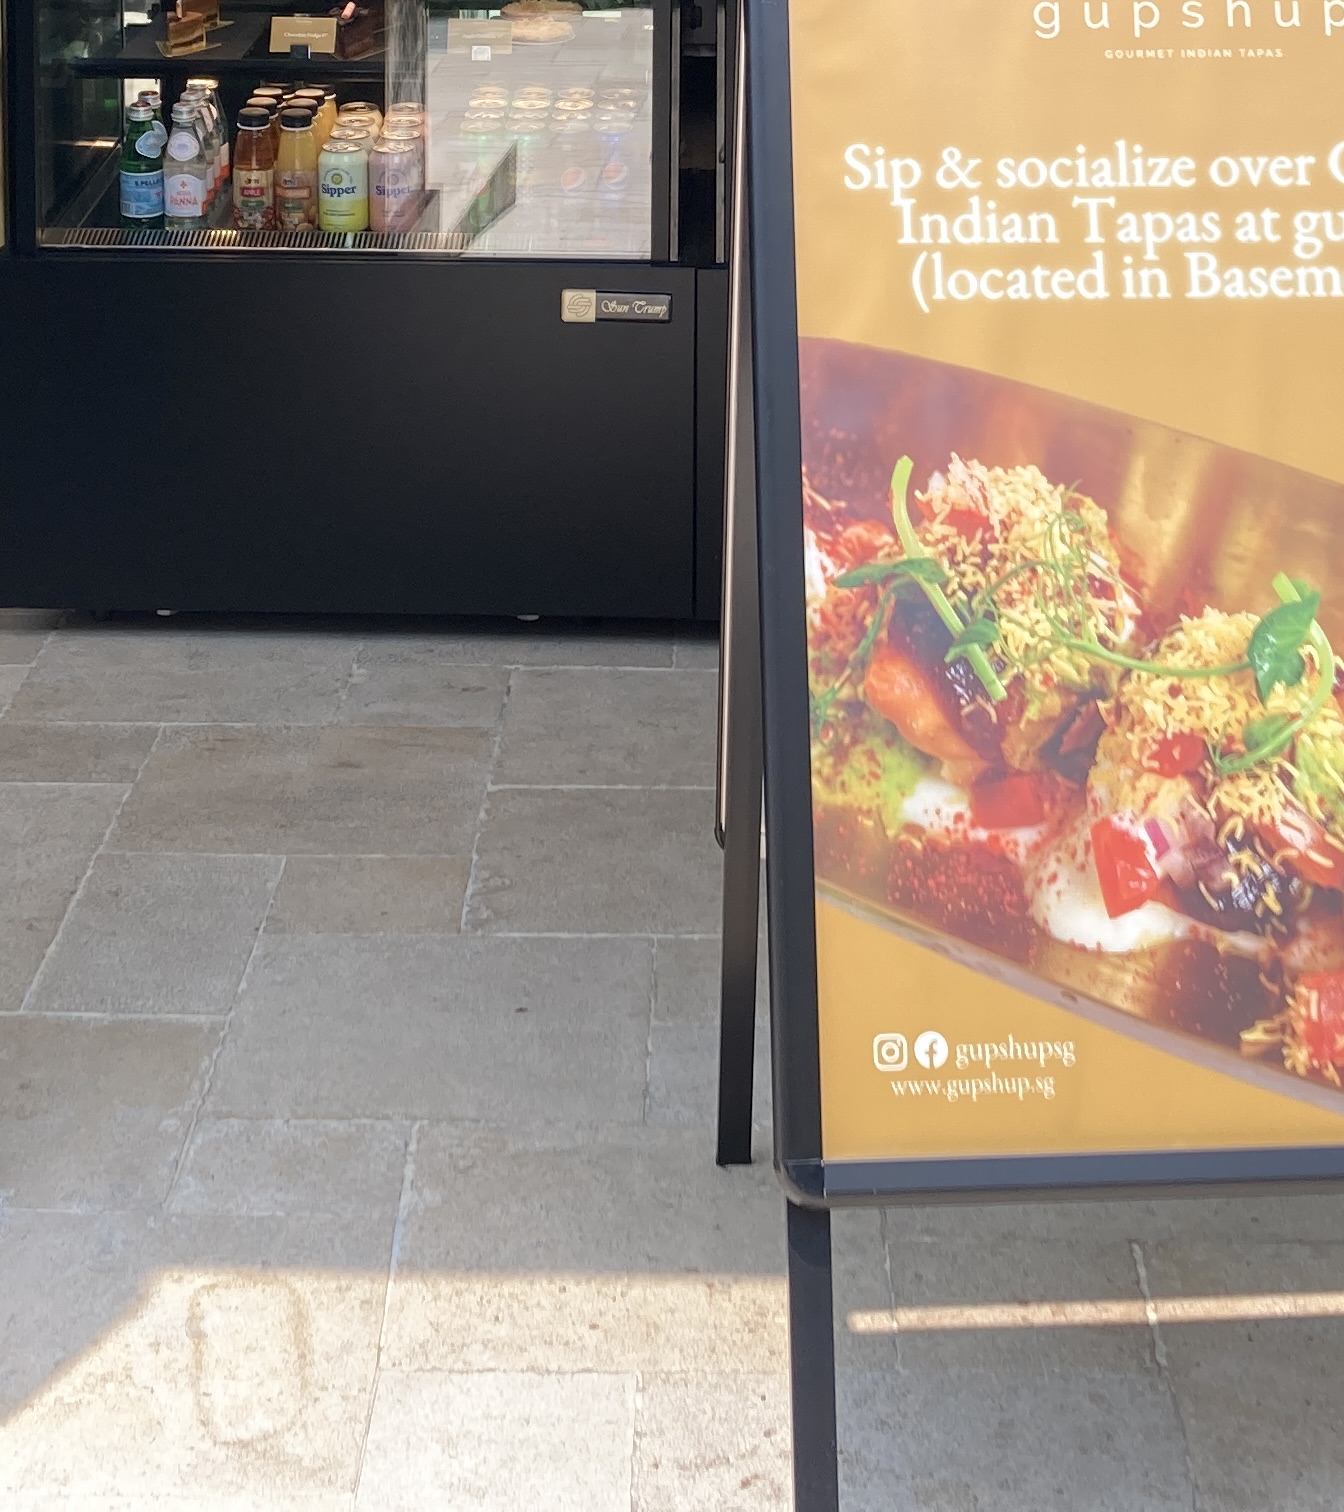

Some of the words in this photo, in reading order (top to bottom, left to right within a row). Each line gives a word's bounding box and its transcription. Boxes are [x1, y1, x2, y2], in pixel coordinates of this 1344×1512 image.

[1104, 49, 1174, 59] GOURMET
[1180, 48, 1233, 58] INDIAN
[1239, 48, 1284, 58] TAPAS
[321, 183, 357, 197] Sipper
[843, 143, 921, 206] Sip
[935, 146, 982, 189] &
[996, 139, 1197, 188] socialize
[1209, 153, 1316, 187] over
[897, 195, 1060, 244] Indian
[1071, 196, 1221, 261] Tapas
[1235, 208, 1281, 242] at
[912, 250, 1110, 313] (located
[1121, 255, 1172, 298] in
[955, 1033, 1076, 1070] gupshupsg
[891, 1071, 1056, 1102] www.gupshup.sg
